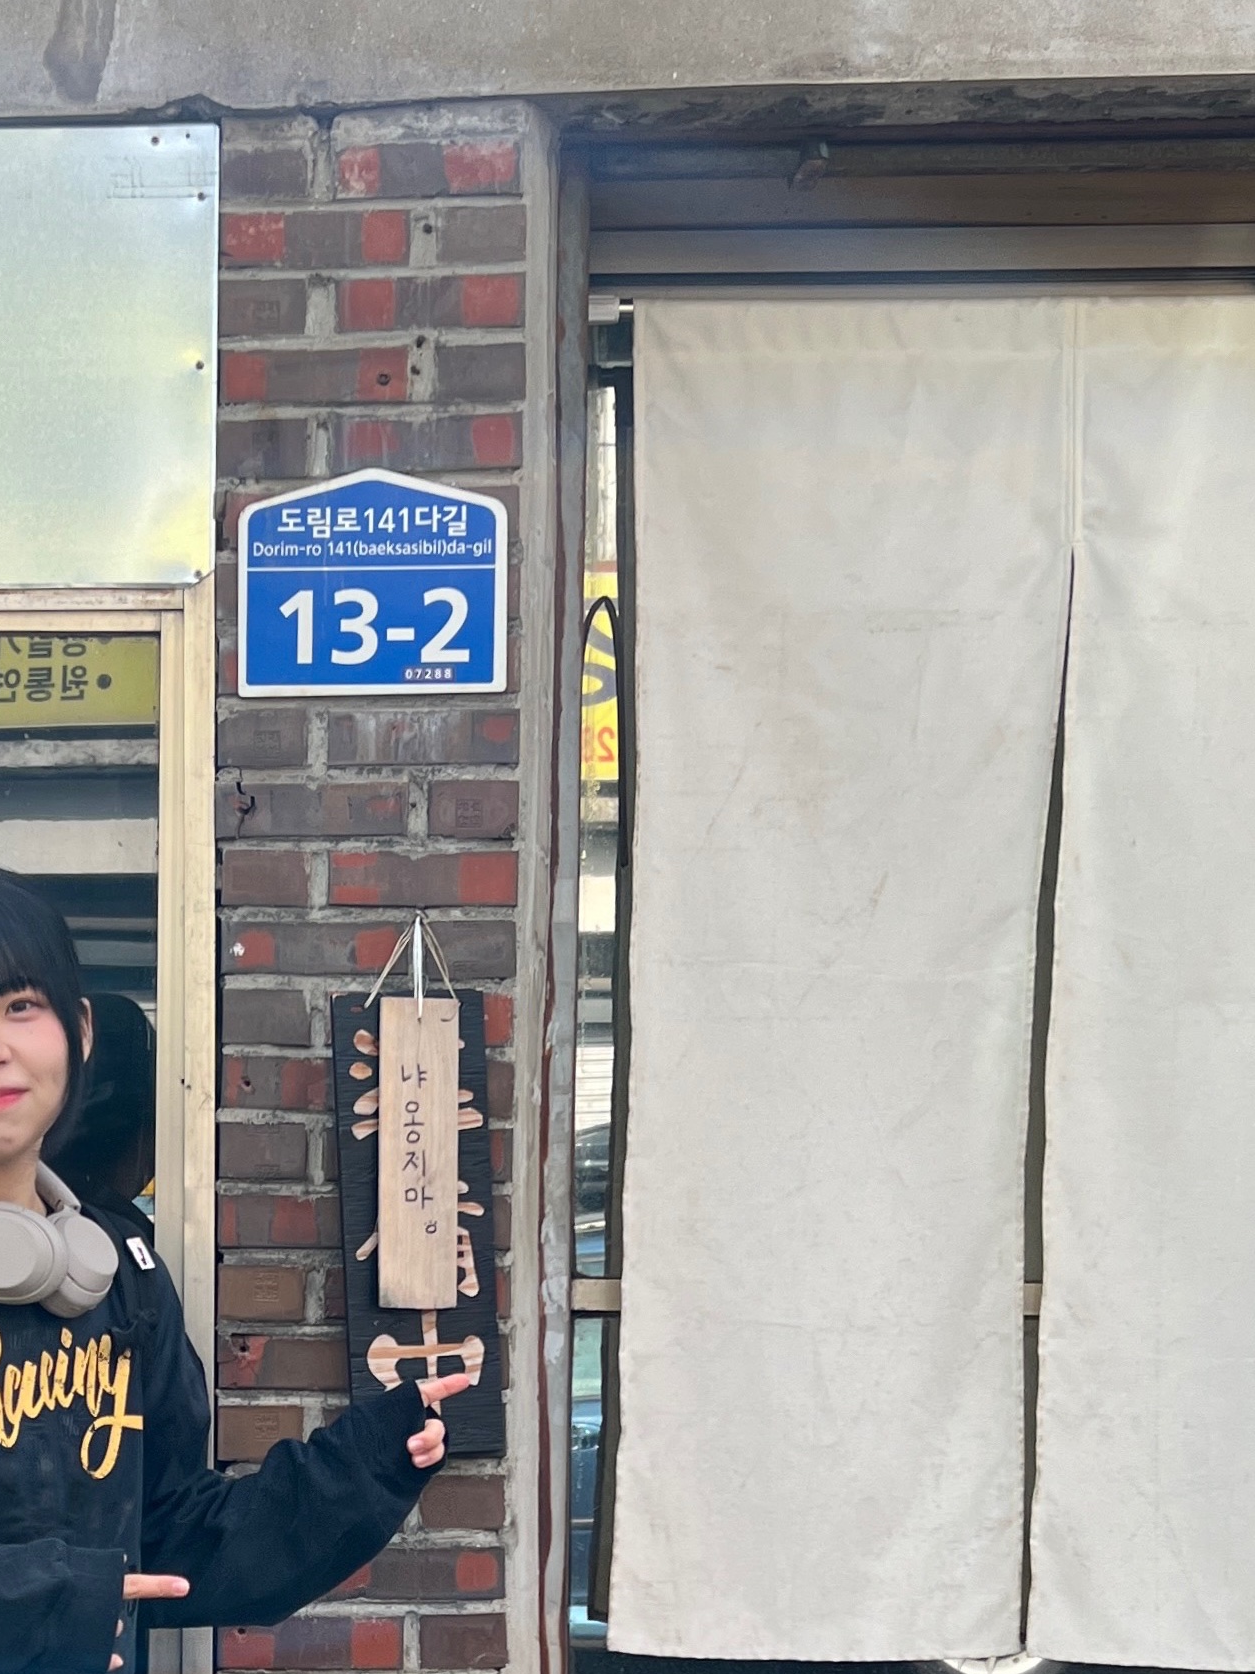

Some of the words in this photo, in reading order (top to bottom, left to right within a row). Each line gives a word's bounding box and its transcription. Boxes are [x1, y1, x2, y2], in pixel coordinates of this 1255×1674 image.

[277, 504, 468, 539] 도림로141다길
[252, 541, 322, 557] Dorim-ro
[328, 538, 493, 557] 141(baeksasibil)da-gil
[278, 586, 471, 666] 13-2
[405, 667, 453, 680] 07288
[400, 1063, 434, 1210] 냐옹지마
